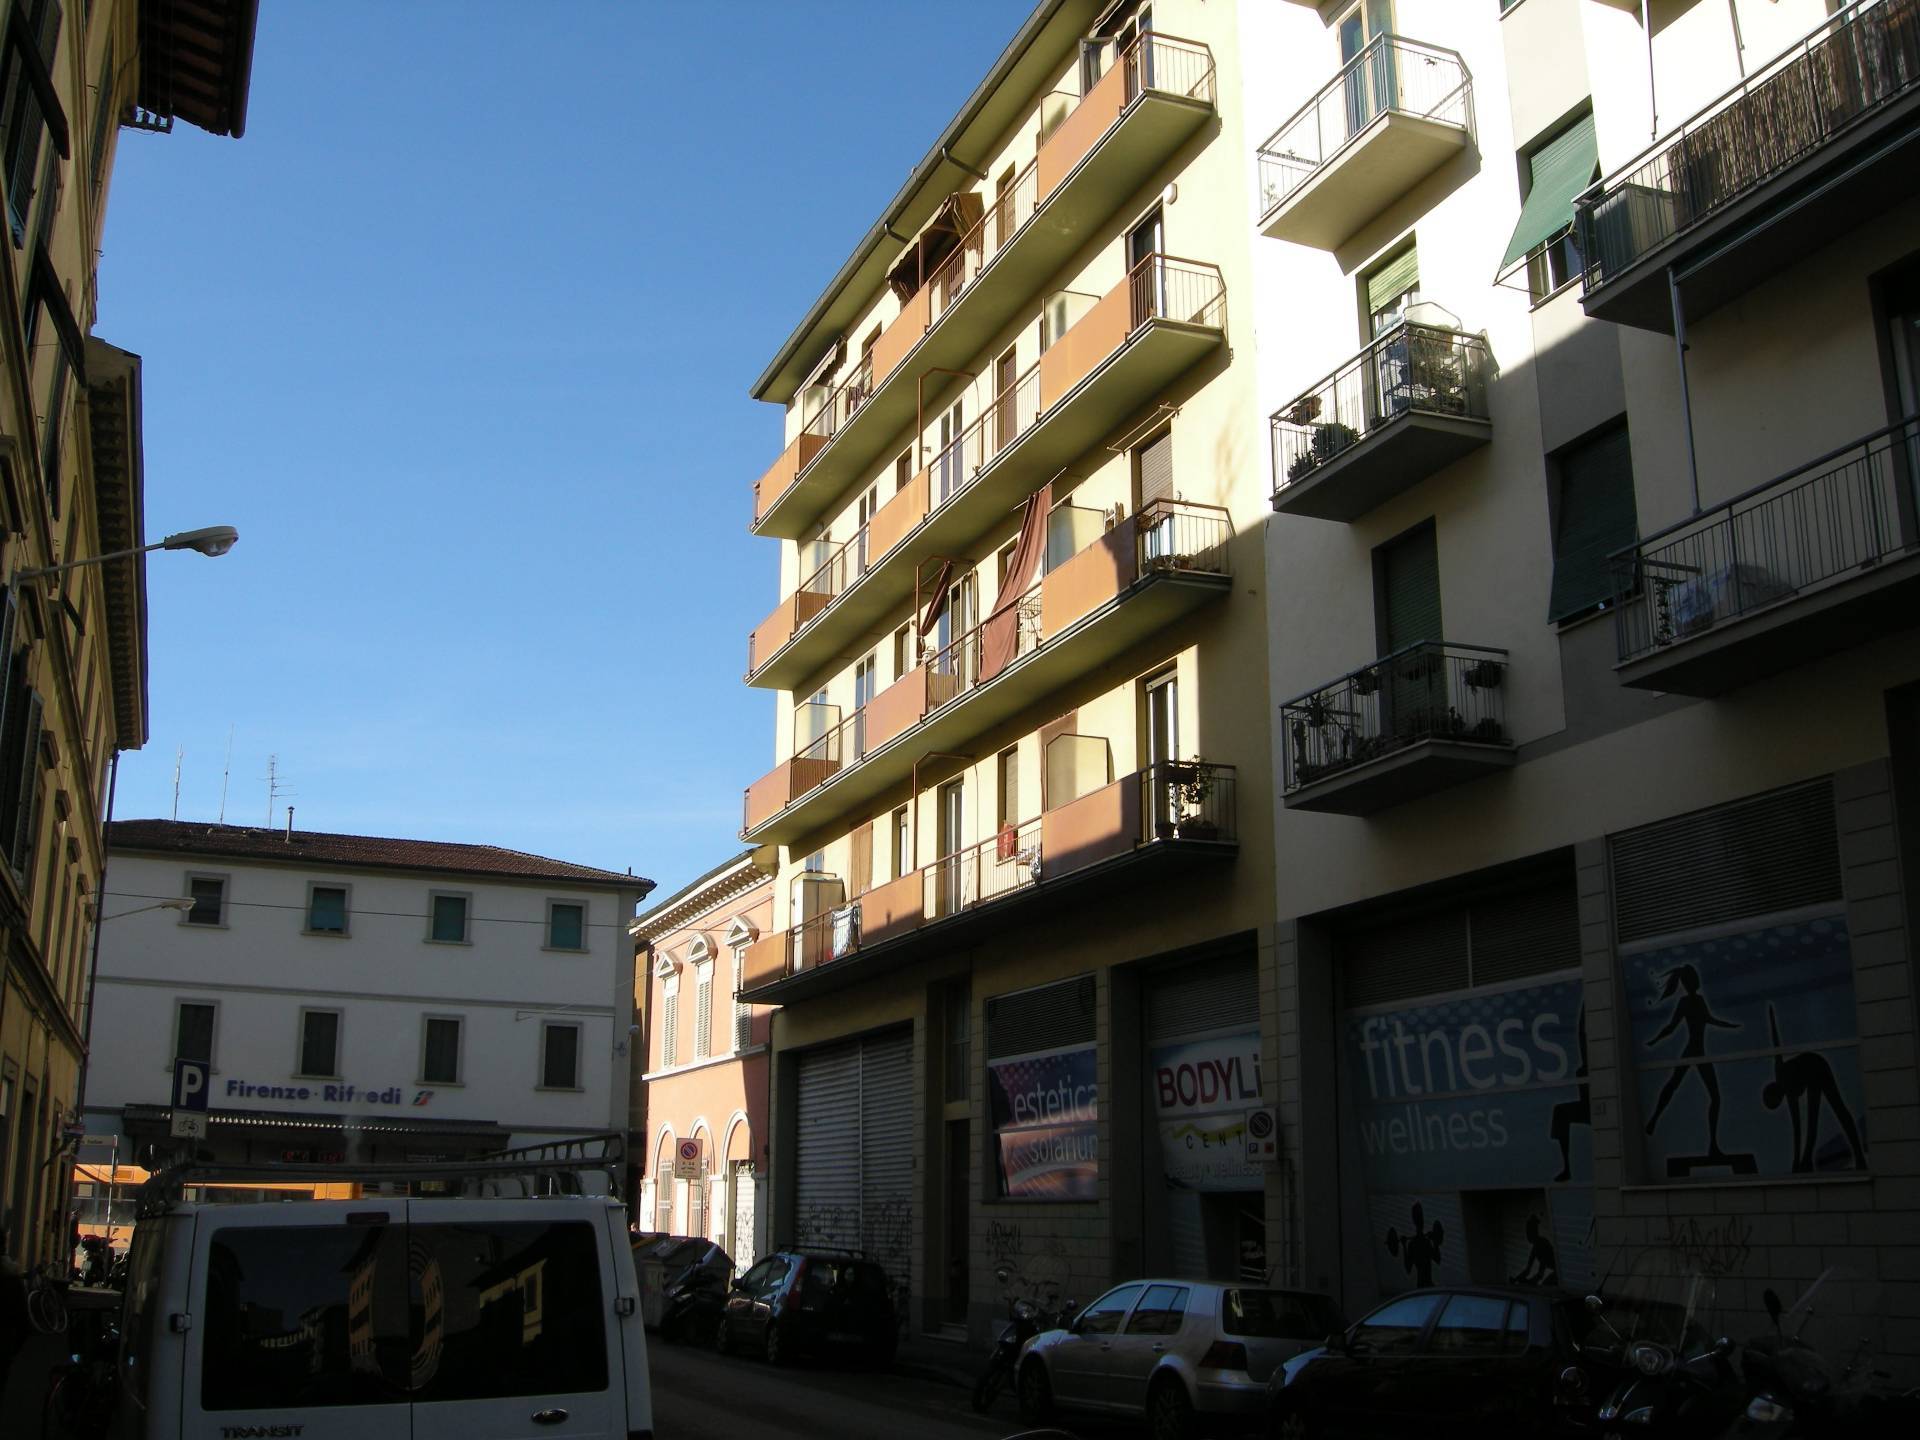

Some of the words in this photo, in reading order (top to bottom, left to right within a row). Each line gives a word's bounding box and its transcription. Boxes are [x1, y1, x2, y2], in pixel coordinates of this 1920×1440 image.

[1359, 1012, 1569, 1100] fitness
[180, 1064, 203, 1106] P
[226, 1079, 310, 1101] Firenze
[323, 1084, 401, 1106] Rifredi
[1015, 1074, 1098, 1125] estetica
[1359, 1103, 1509, 1156] wellness
[220, 1423, 304, 1440] TRANSIT
